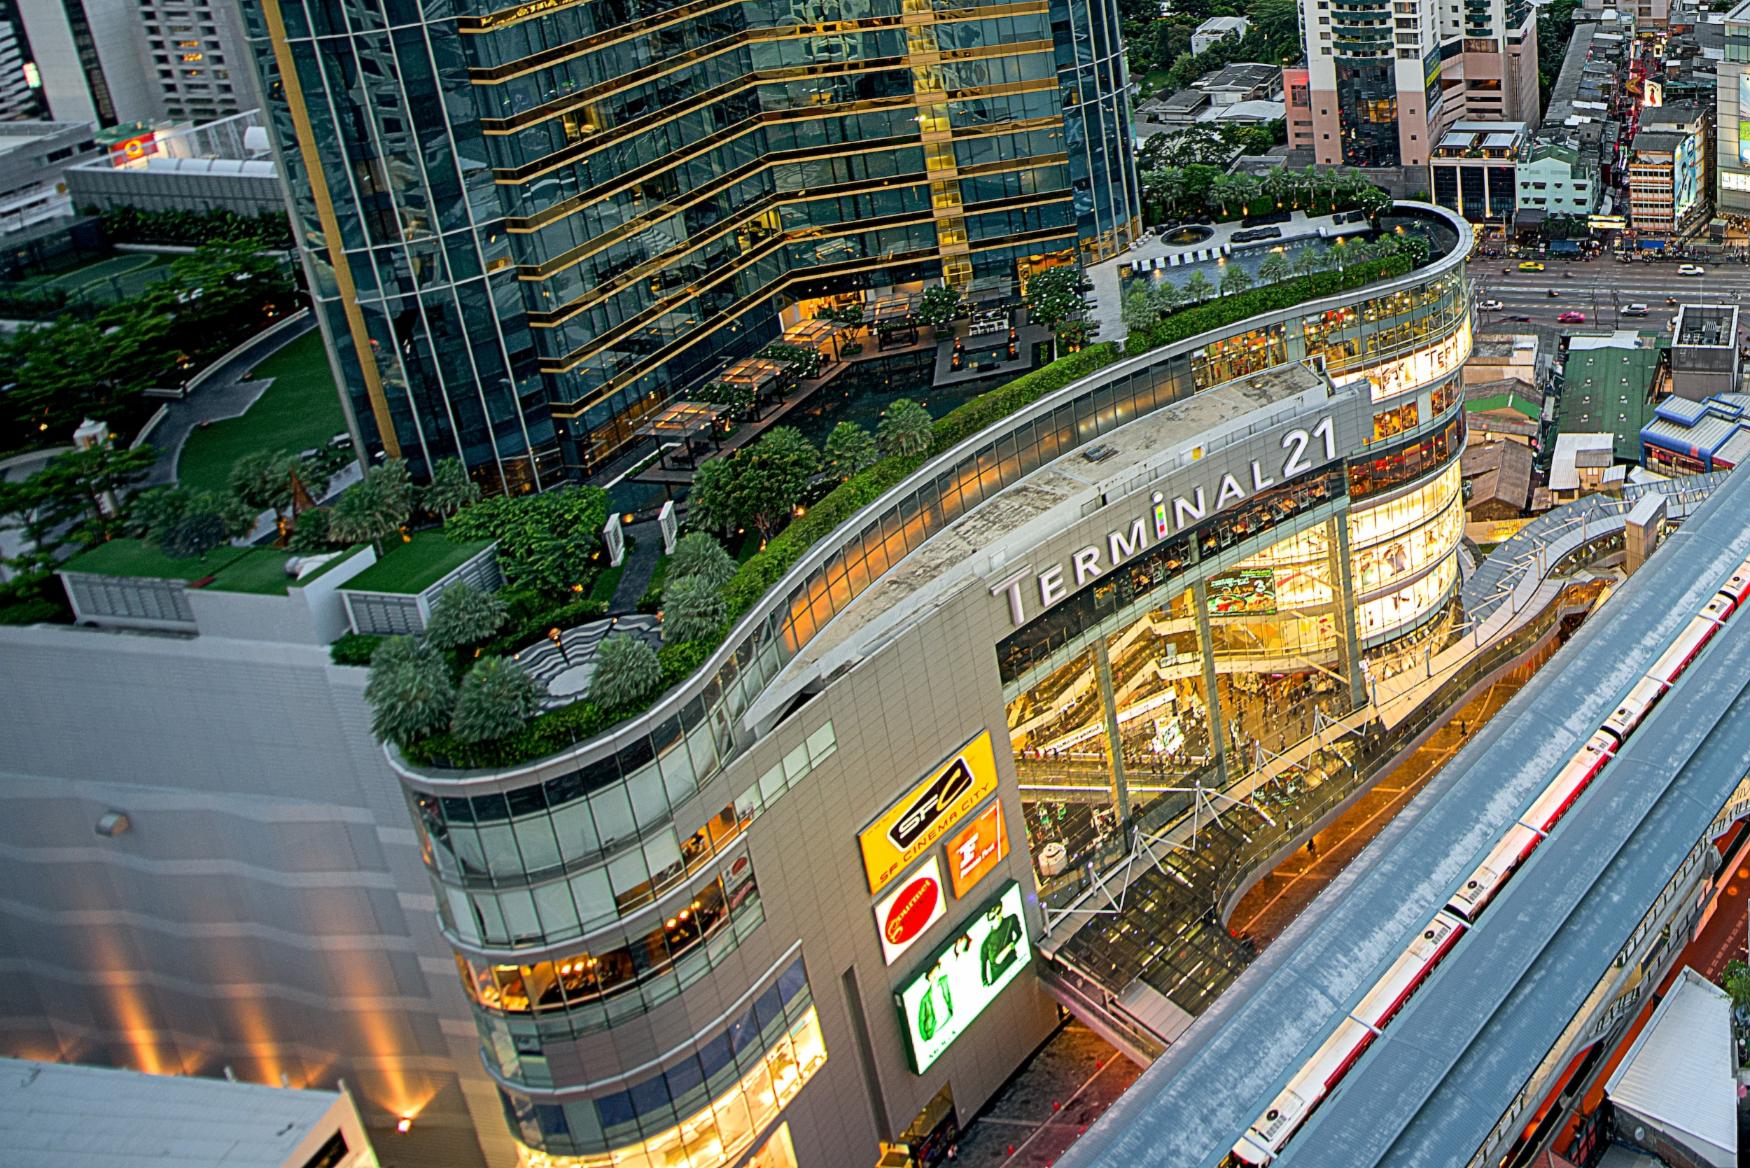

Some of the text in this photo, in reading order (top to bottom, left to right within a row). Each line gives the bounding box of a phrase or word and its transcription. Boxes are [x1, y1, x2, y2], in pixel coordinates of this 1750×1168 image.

[990, 415, 1337, 626] TERMINAL 21
[879, 862, 899, 883] SF
[903, 811, 958, 862] CINEMA
[961, 782, 990, 812] CITY
[898, 768, 971, 840] SFC
[887, 879, 932, 943] Gourmet
